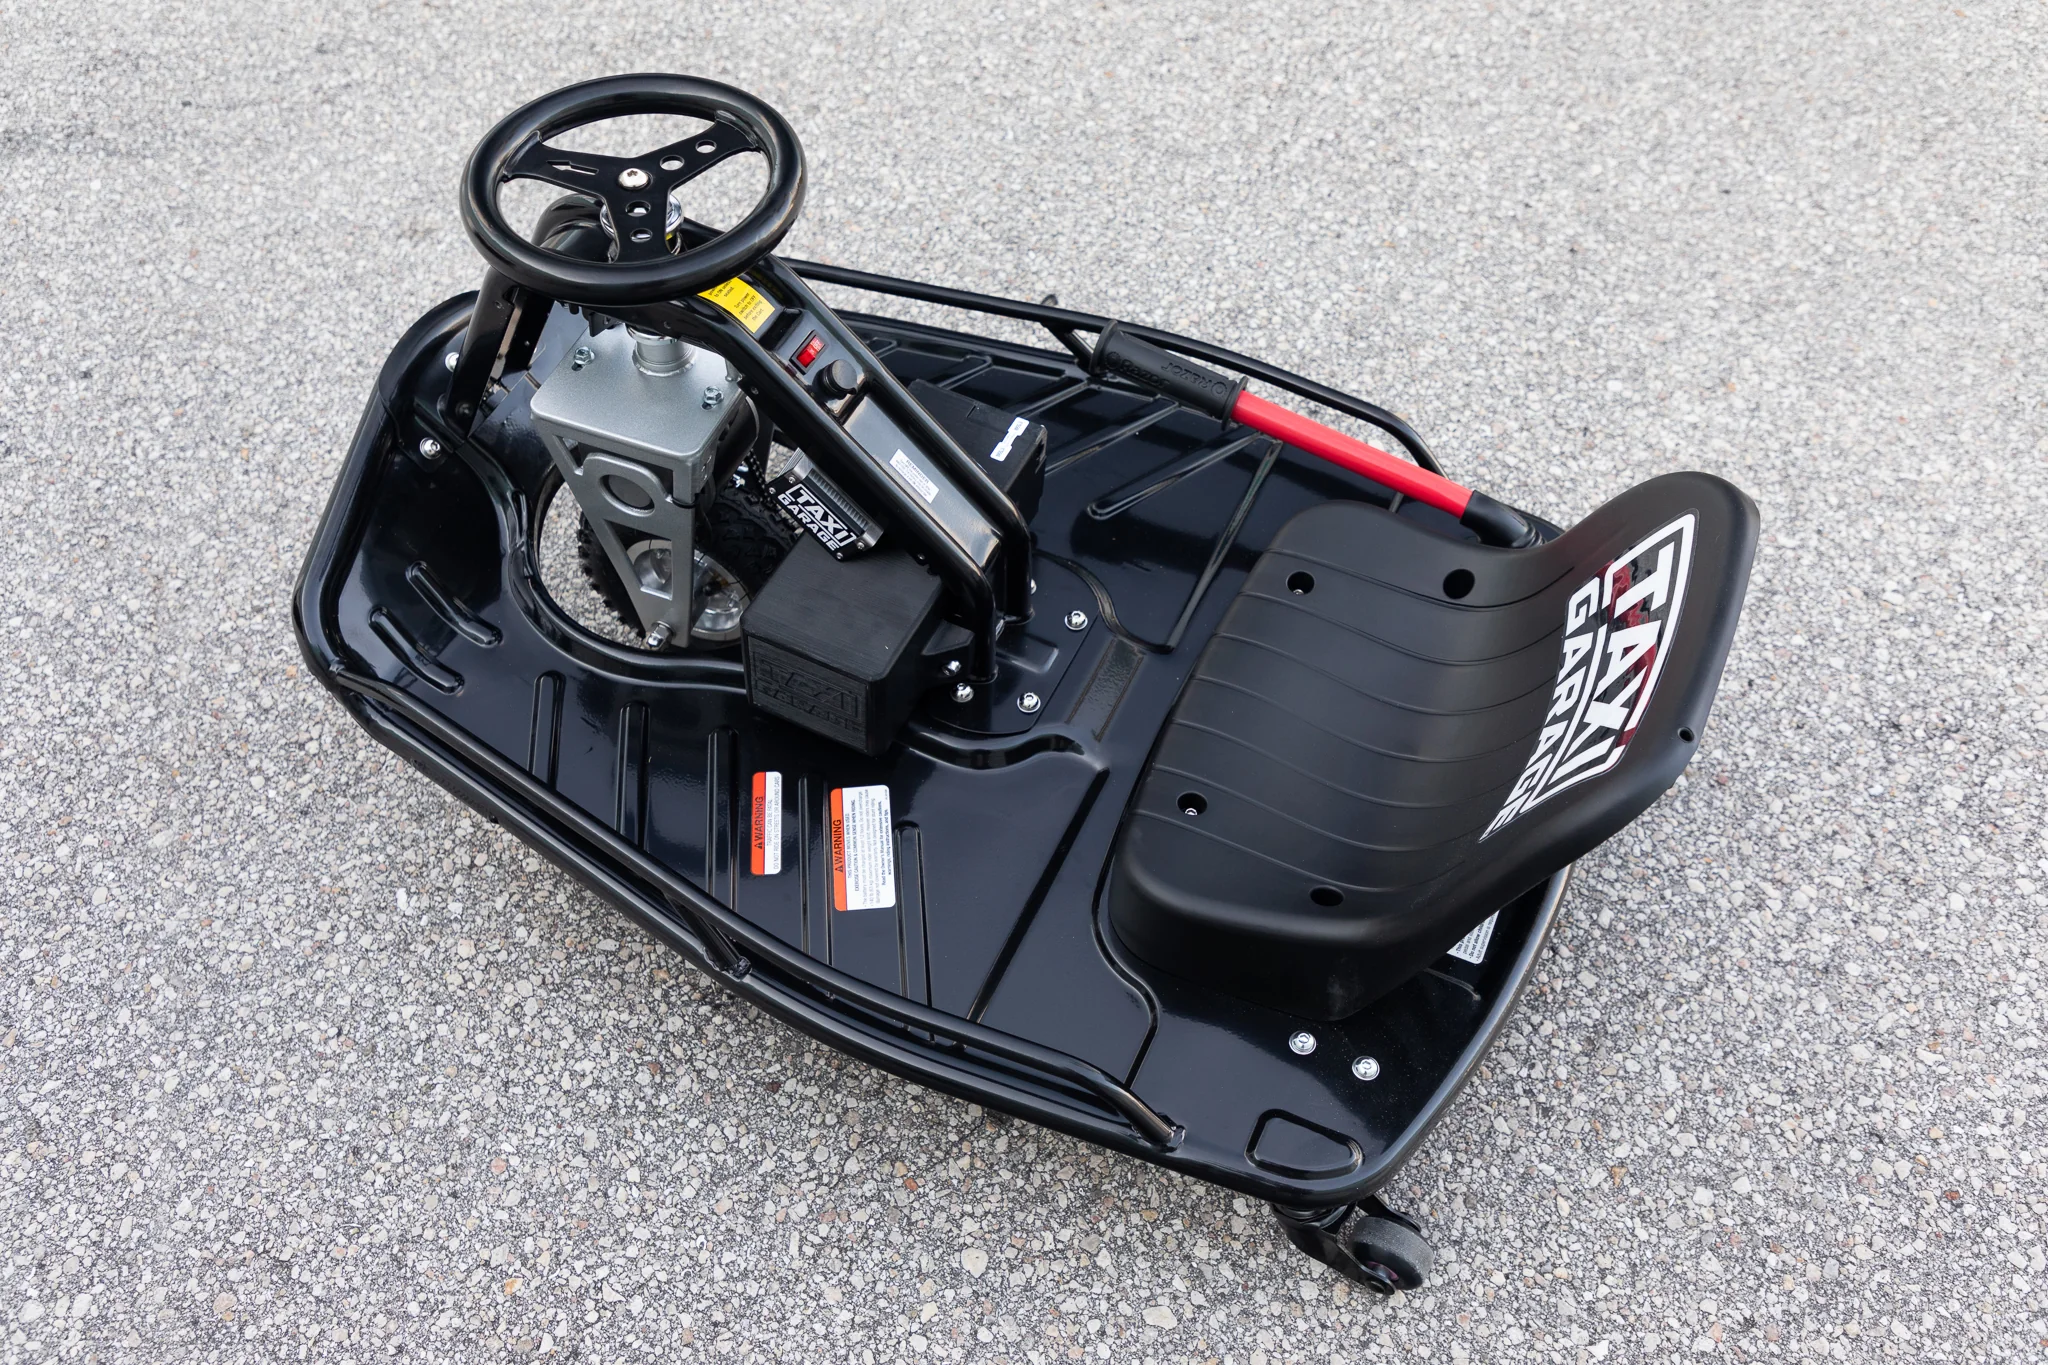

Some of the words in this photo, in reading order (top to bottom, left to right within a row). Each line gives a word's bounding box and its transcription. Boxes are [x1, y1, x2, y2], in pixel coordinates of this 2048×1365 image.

[778, 493, 840, 551] GARAGE
[796, 489, 849, 541] TAXI
[1548, 541, 1675, 786] TAXI
[1479, 576, 1600, 842] GARAGE
[755, 796, 763, 841] WARNING
[833, 820, 842, 864] WARNING
